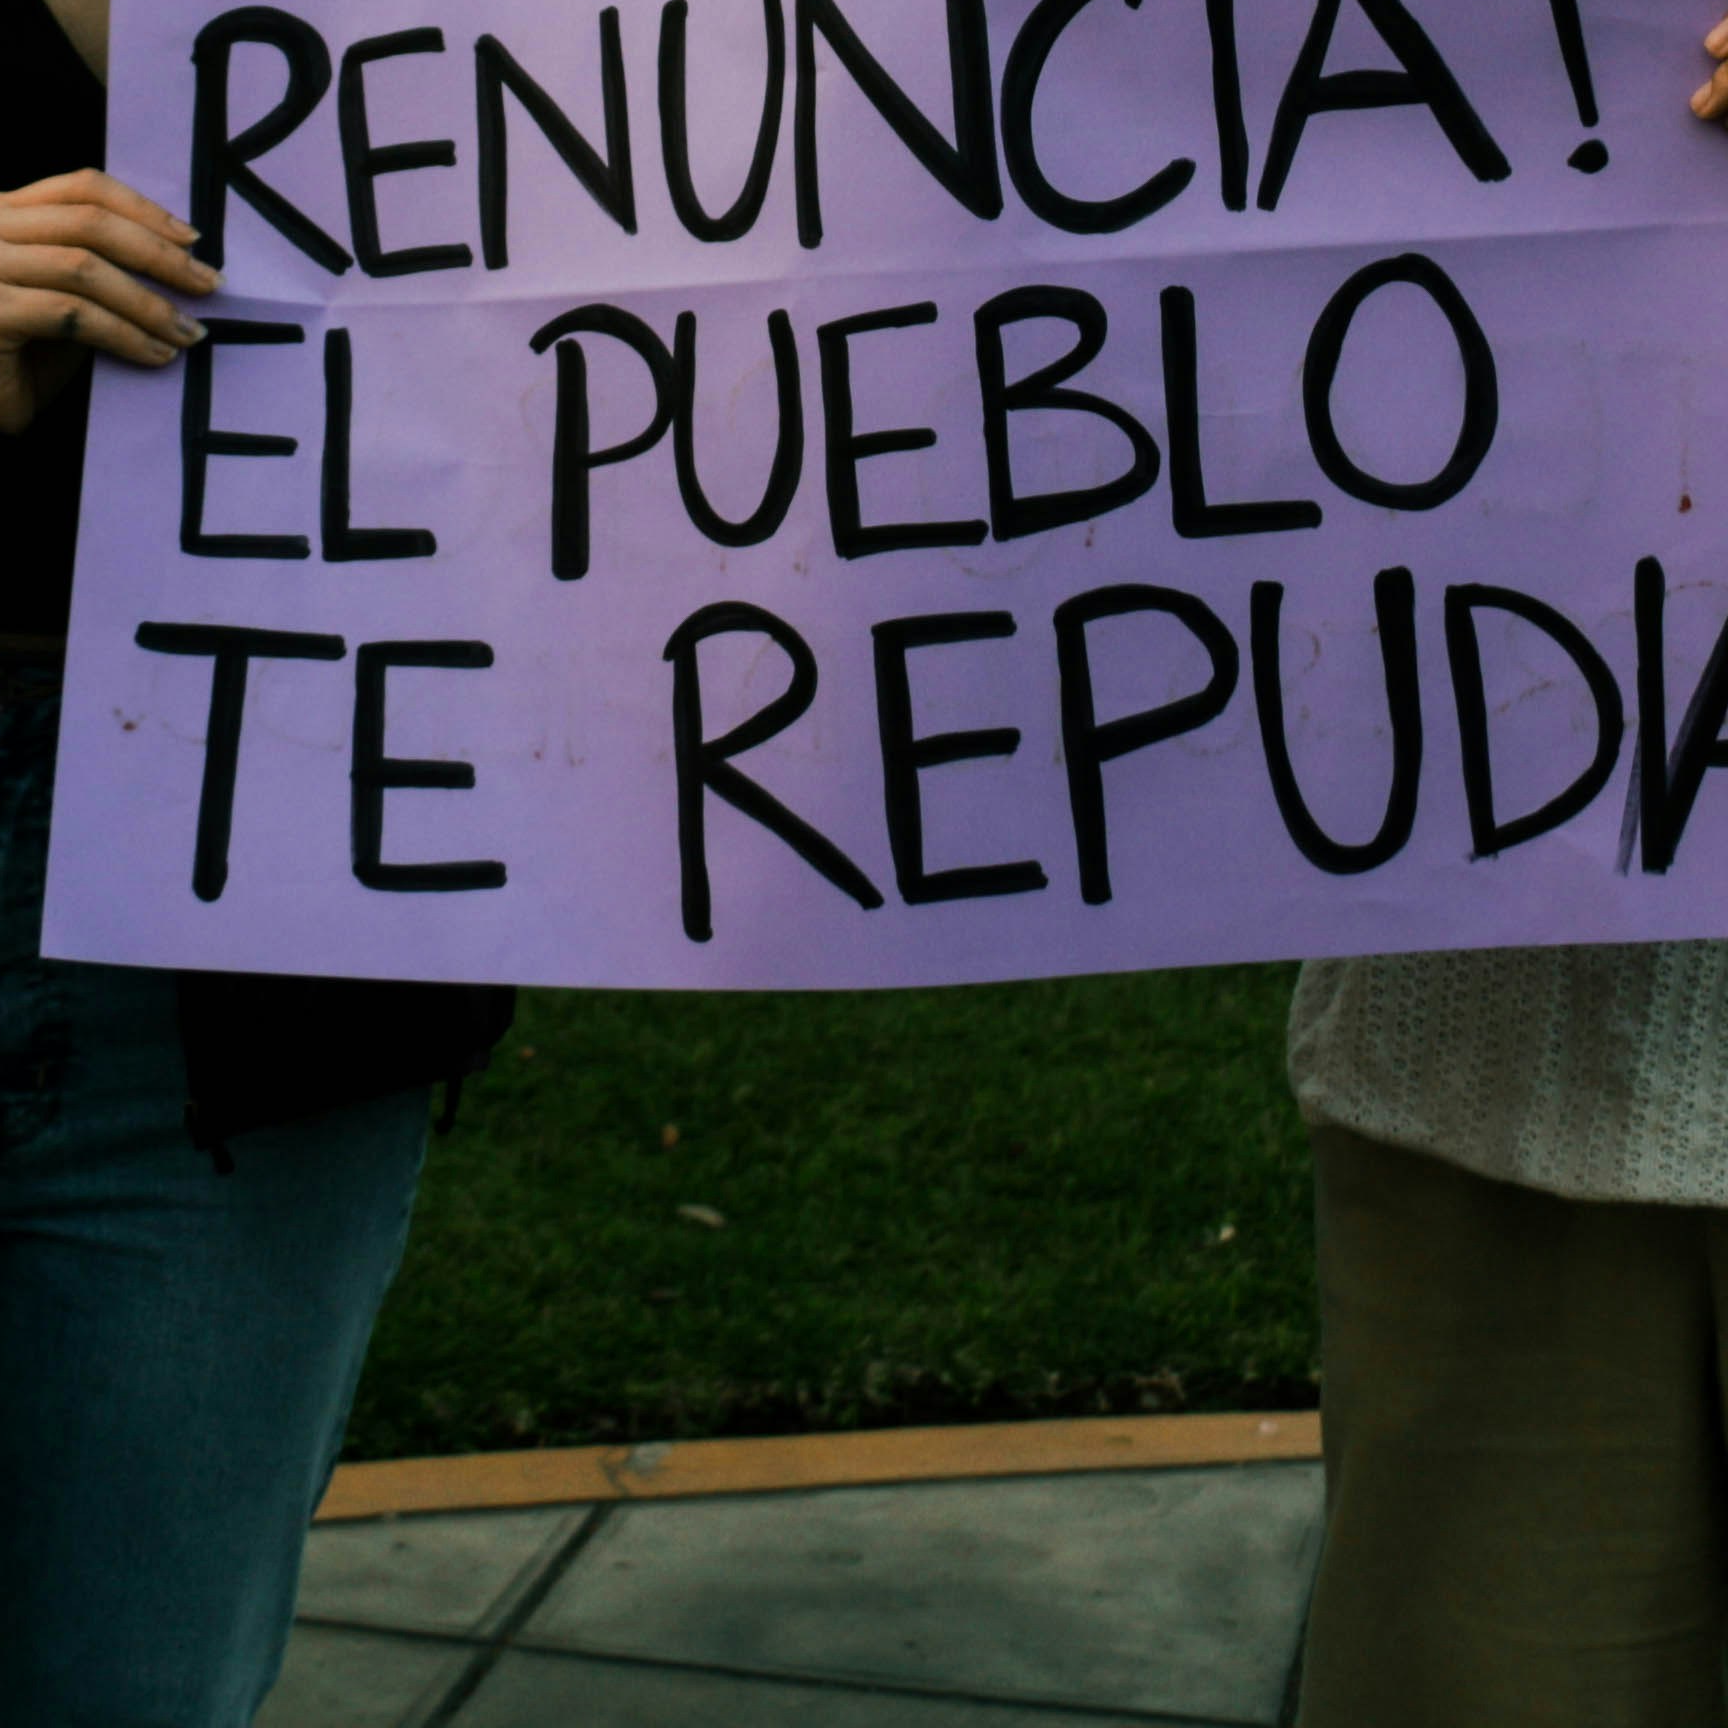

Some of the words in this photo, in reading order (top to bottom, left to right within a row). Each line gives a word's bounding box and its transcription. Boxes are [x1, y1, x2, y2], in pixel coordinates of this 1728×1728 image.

[179, 318, 437, 563] EL
[529, 252, 1499, 581] PUEBLO
[134, 621, 507, 903] TE
